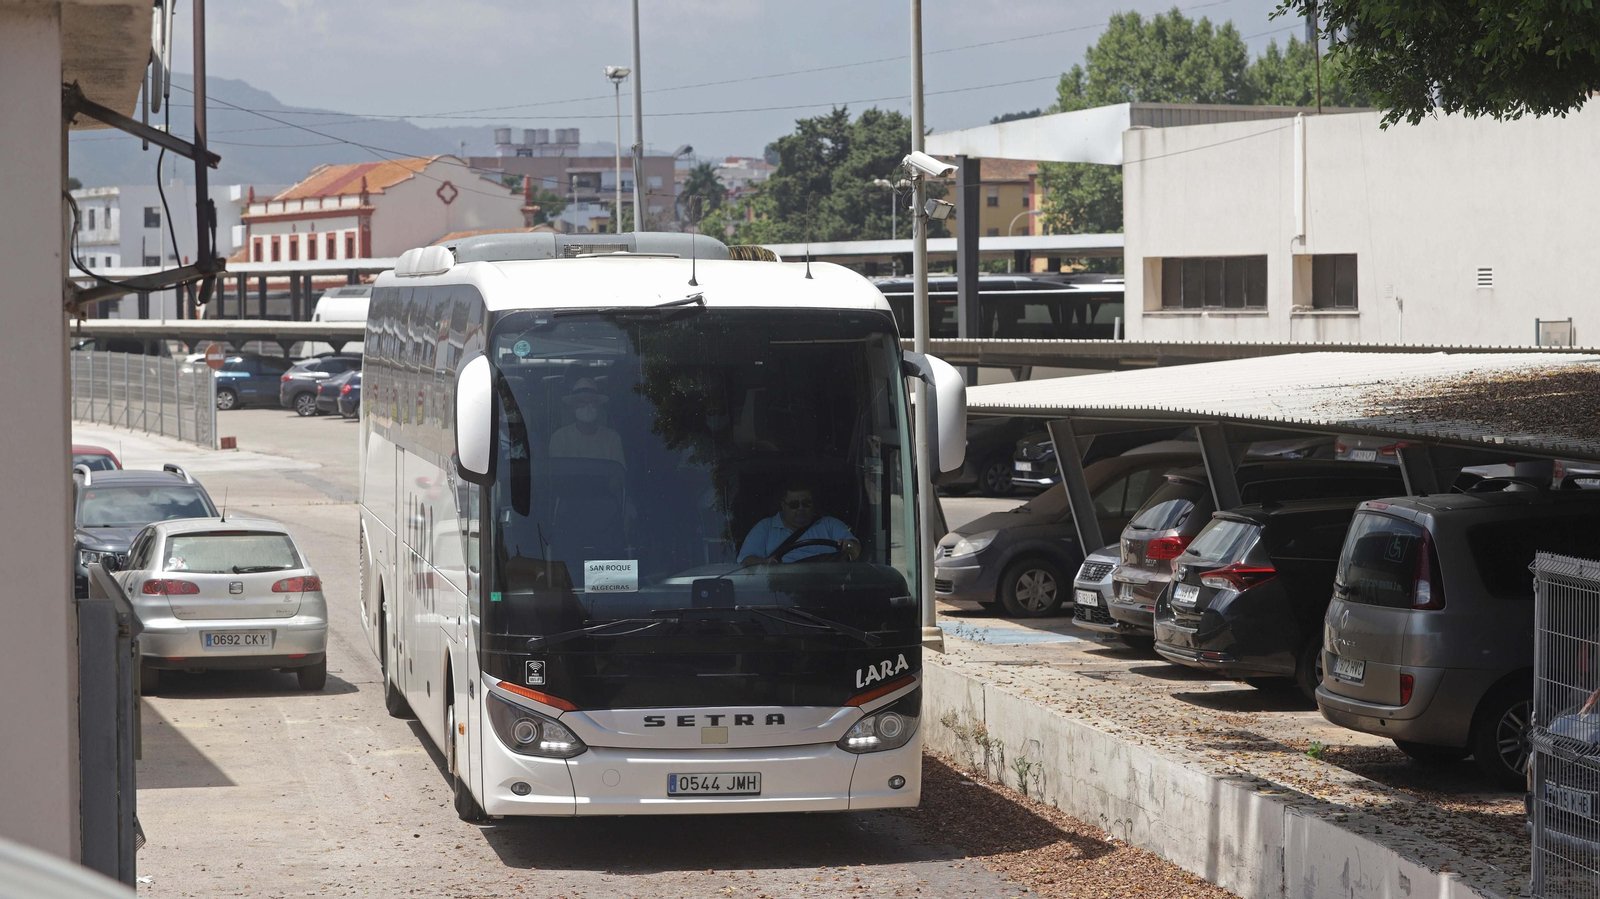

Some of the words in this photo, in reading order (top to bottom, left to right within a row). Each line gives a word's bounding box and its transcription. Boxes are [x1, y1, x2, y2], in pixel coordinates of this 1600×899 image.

[589, 564, 604, 572] SAN
[605, 564, 632, 572] ROQUE
[213, 634, 240, 645] 0692
[244, 634, 266, 645] CKY
[855, 653, 909, 689] LARA
[643, 713, 786, 727] SETRA
[679, 776, 720, 791] 0544
[726, 775, 756, 790] JMH
